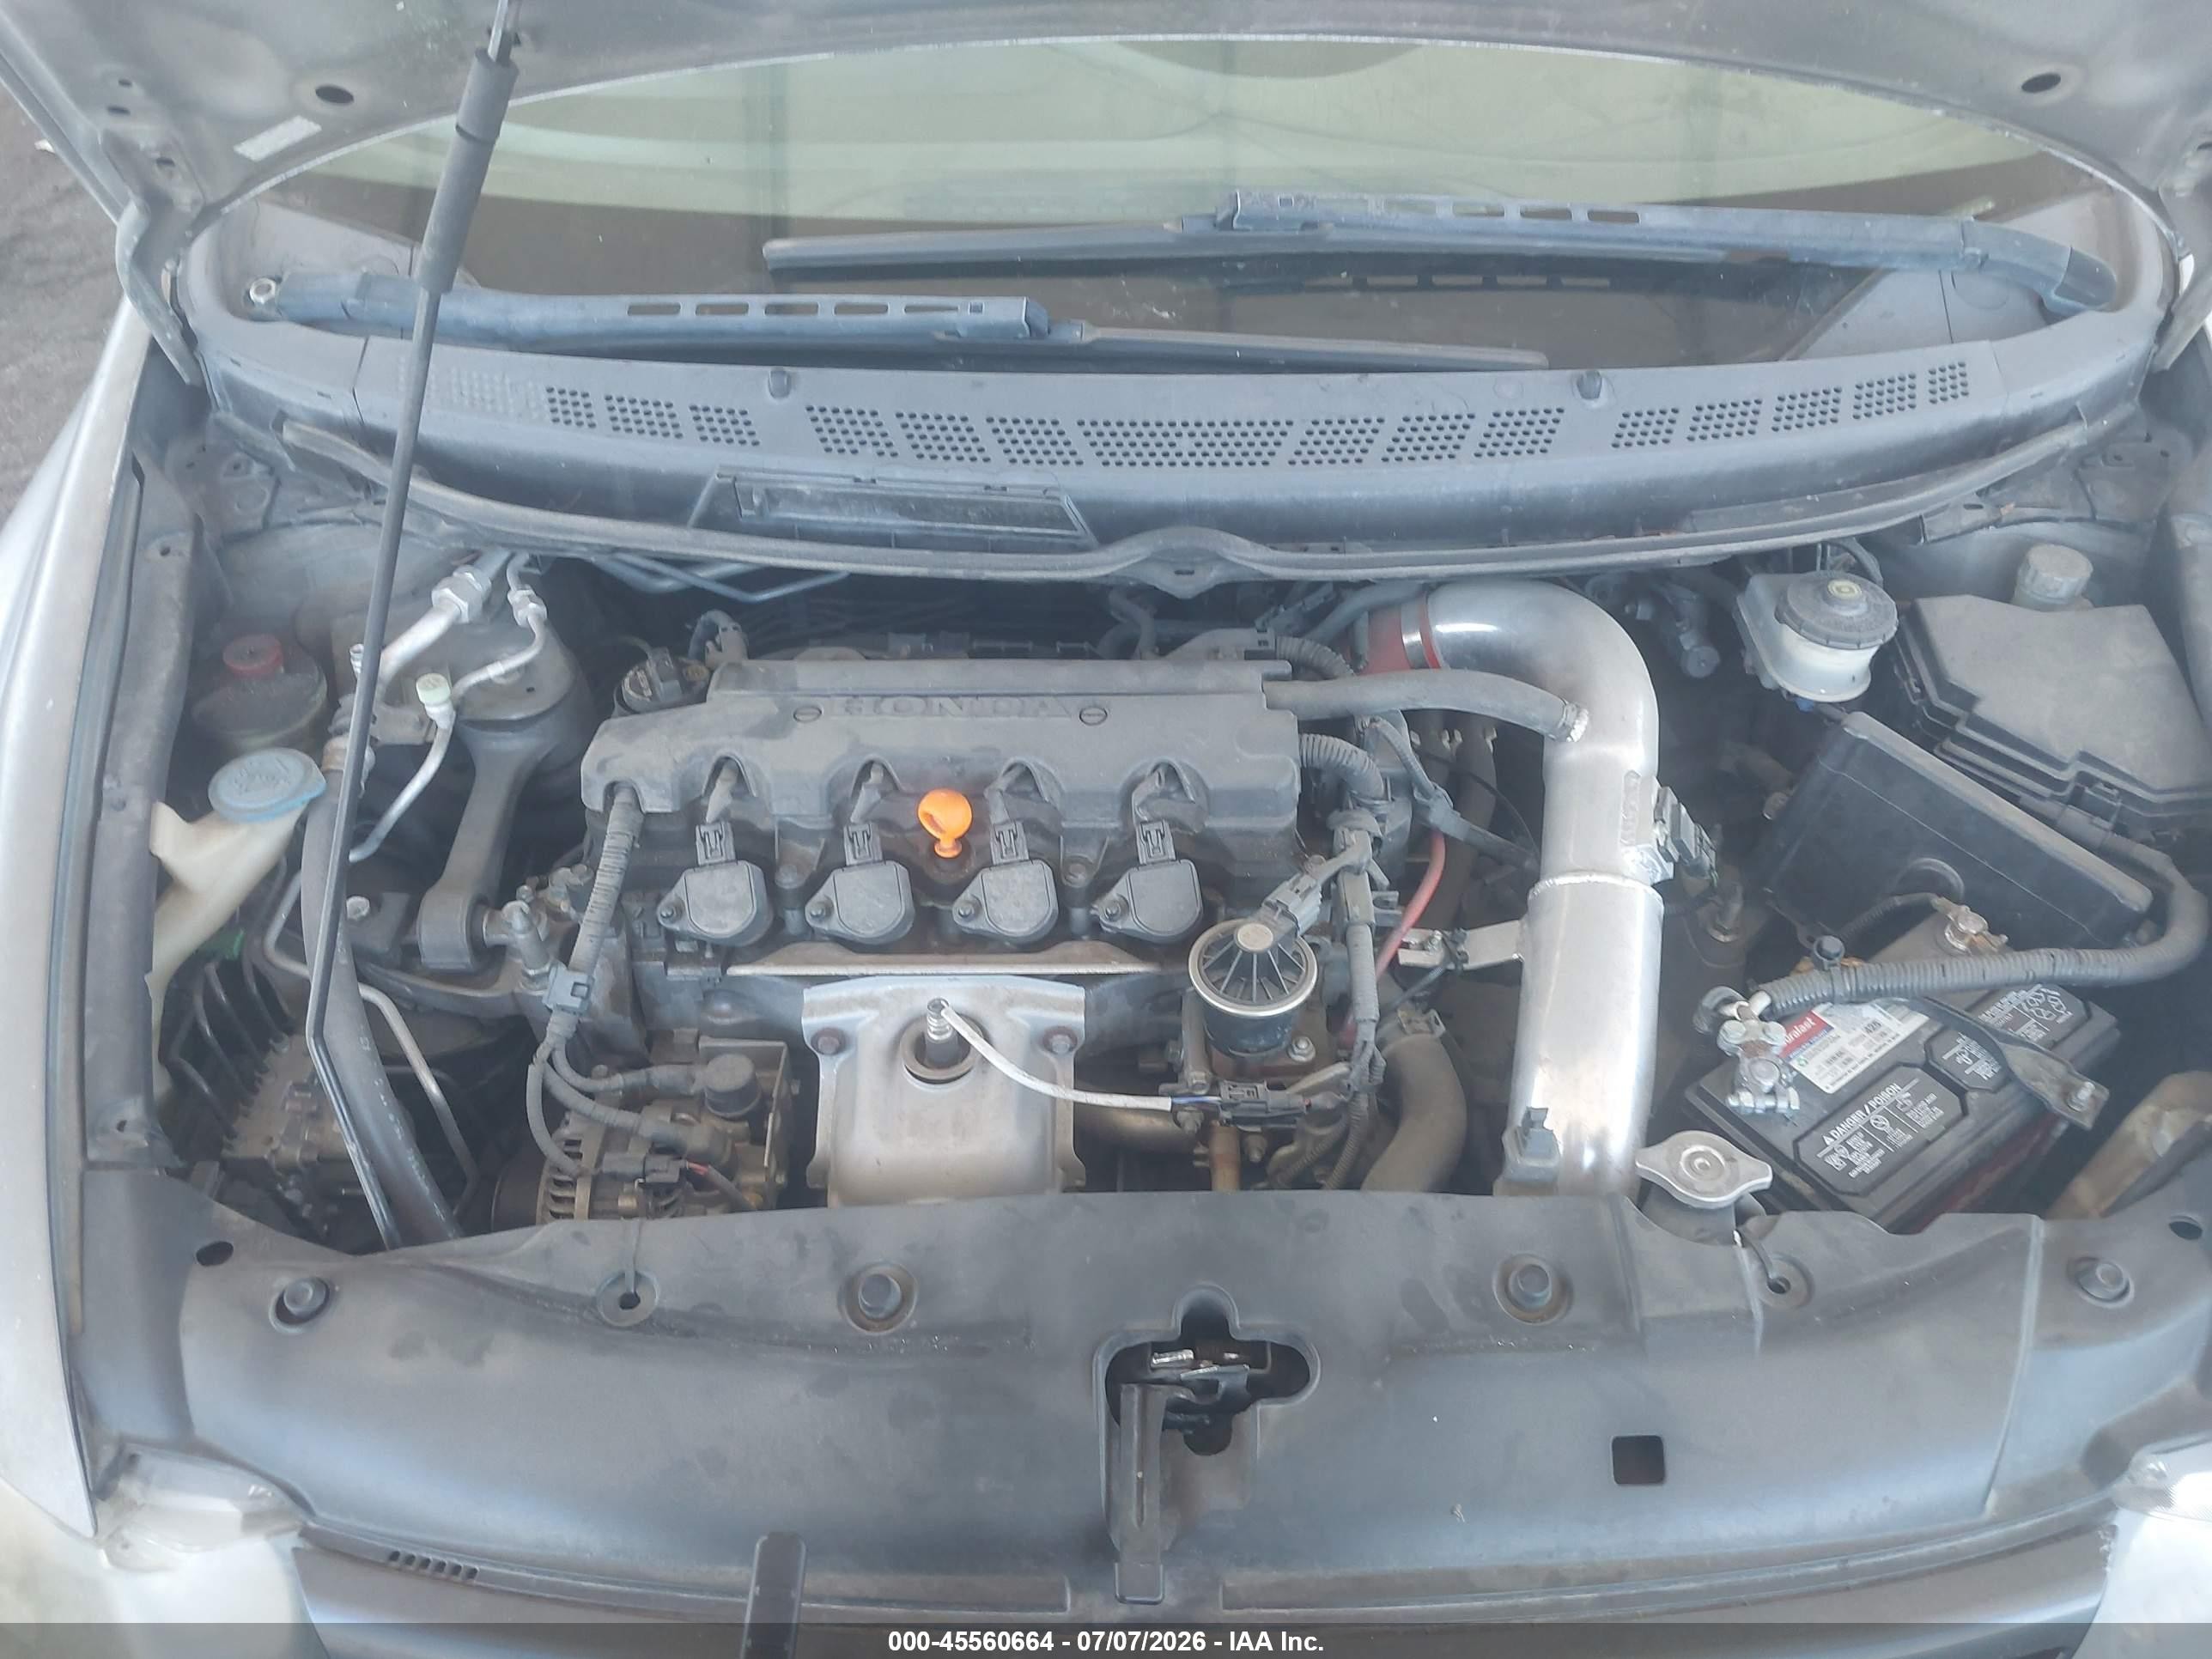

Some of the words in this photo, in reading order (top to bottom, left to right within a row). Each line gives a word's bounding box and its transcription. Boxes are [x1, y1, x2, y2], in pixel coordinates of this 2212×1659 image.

[828, 695, 1073, 717] HONDA
[1784, 1016, 1816, 1044] uralast
[1829, 1109, 1866, 1138] DANGER
[1868, 1083, 1902, 1109] POISON
